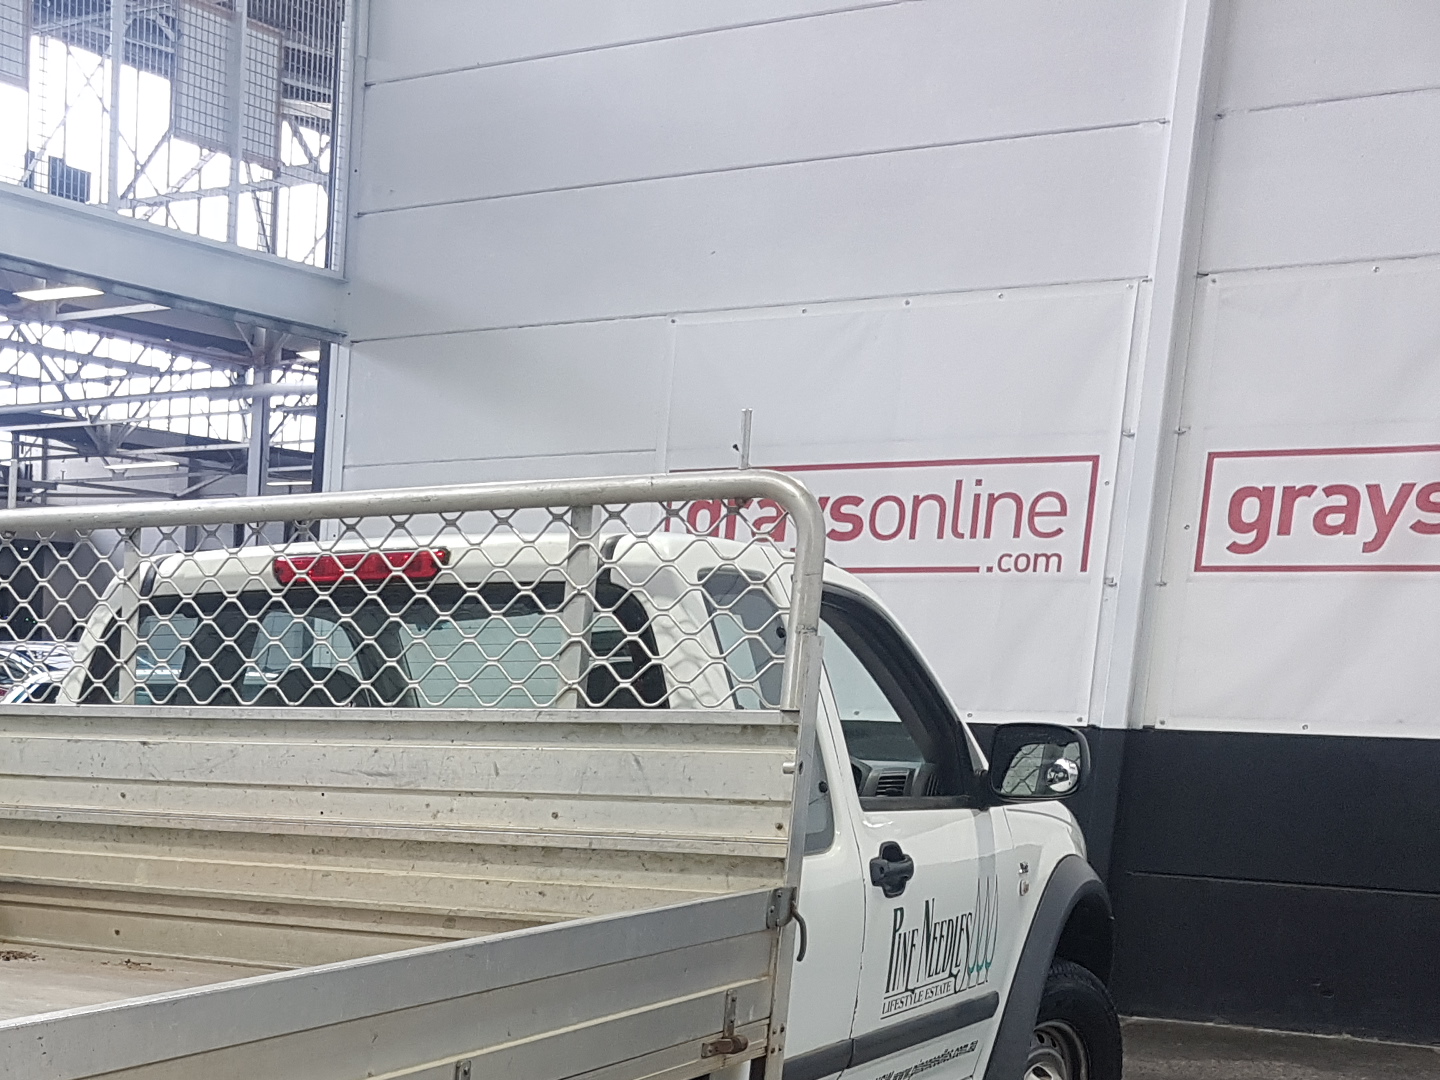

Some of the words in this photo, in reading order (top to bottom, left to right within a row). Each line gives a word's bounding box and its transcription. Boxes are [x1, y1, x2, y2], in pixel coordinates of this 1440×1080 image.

[686, 478, 1068, 543] grasonline
[986, 552, 1063, 574] .com
[881, 990, 924, 1016] LIFESTYLE
[923, 980, 953, 1004] ESTATE
